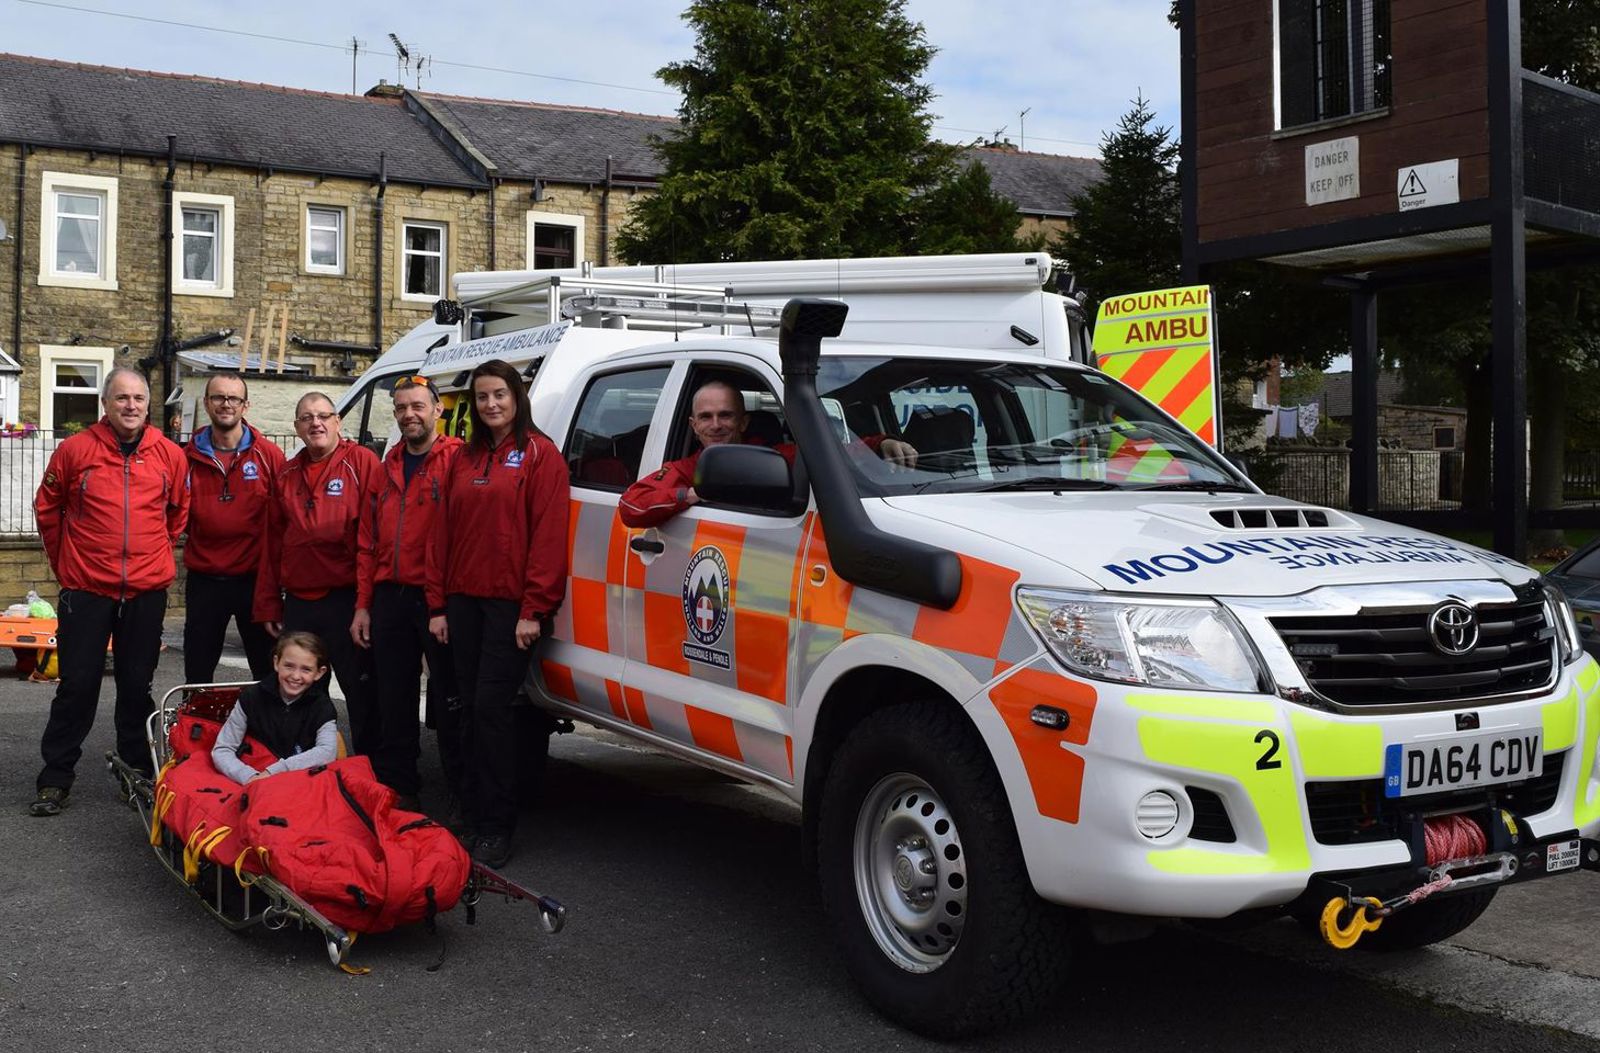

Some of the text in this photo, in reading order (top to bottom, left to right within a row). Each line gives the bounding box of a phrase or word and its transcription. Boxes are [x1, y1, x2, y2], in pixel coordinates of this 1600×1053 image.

[1314, 151, 1349, 168] DANGER
[1310, 173, 1354, 193] KEEP OFF
[1401, 198, 1426, 208] Danger
[465, 338, 502, 359] RESCUE
[500, 325, 569, 352] AMBULANCE
[1125, 316, 1208, 344] AMBU
[684, 549, 729, 592] MOUNTAIN RESCUE
[1102, 535, 1369, 586] MOUNTAIN
[1254, 729, 1282, 770] 2
[1406, 735, 1539, 789] DA64 CDV
[1388, 775, 1399, 787] GB
[1548, 861, 1558, 870] LIFT
